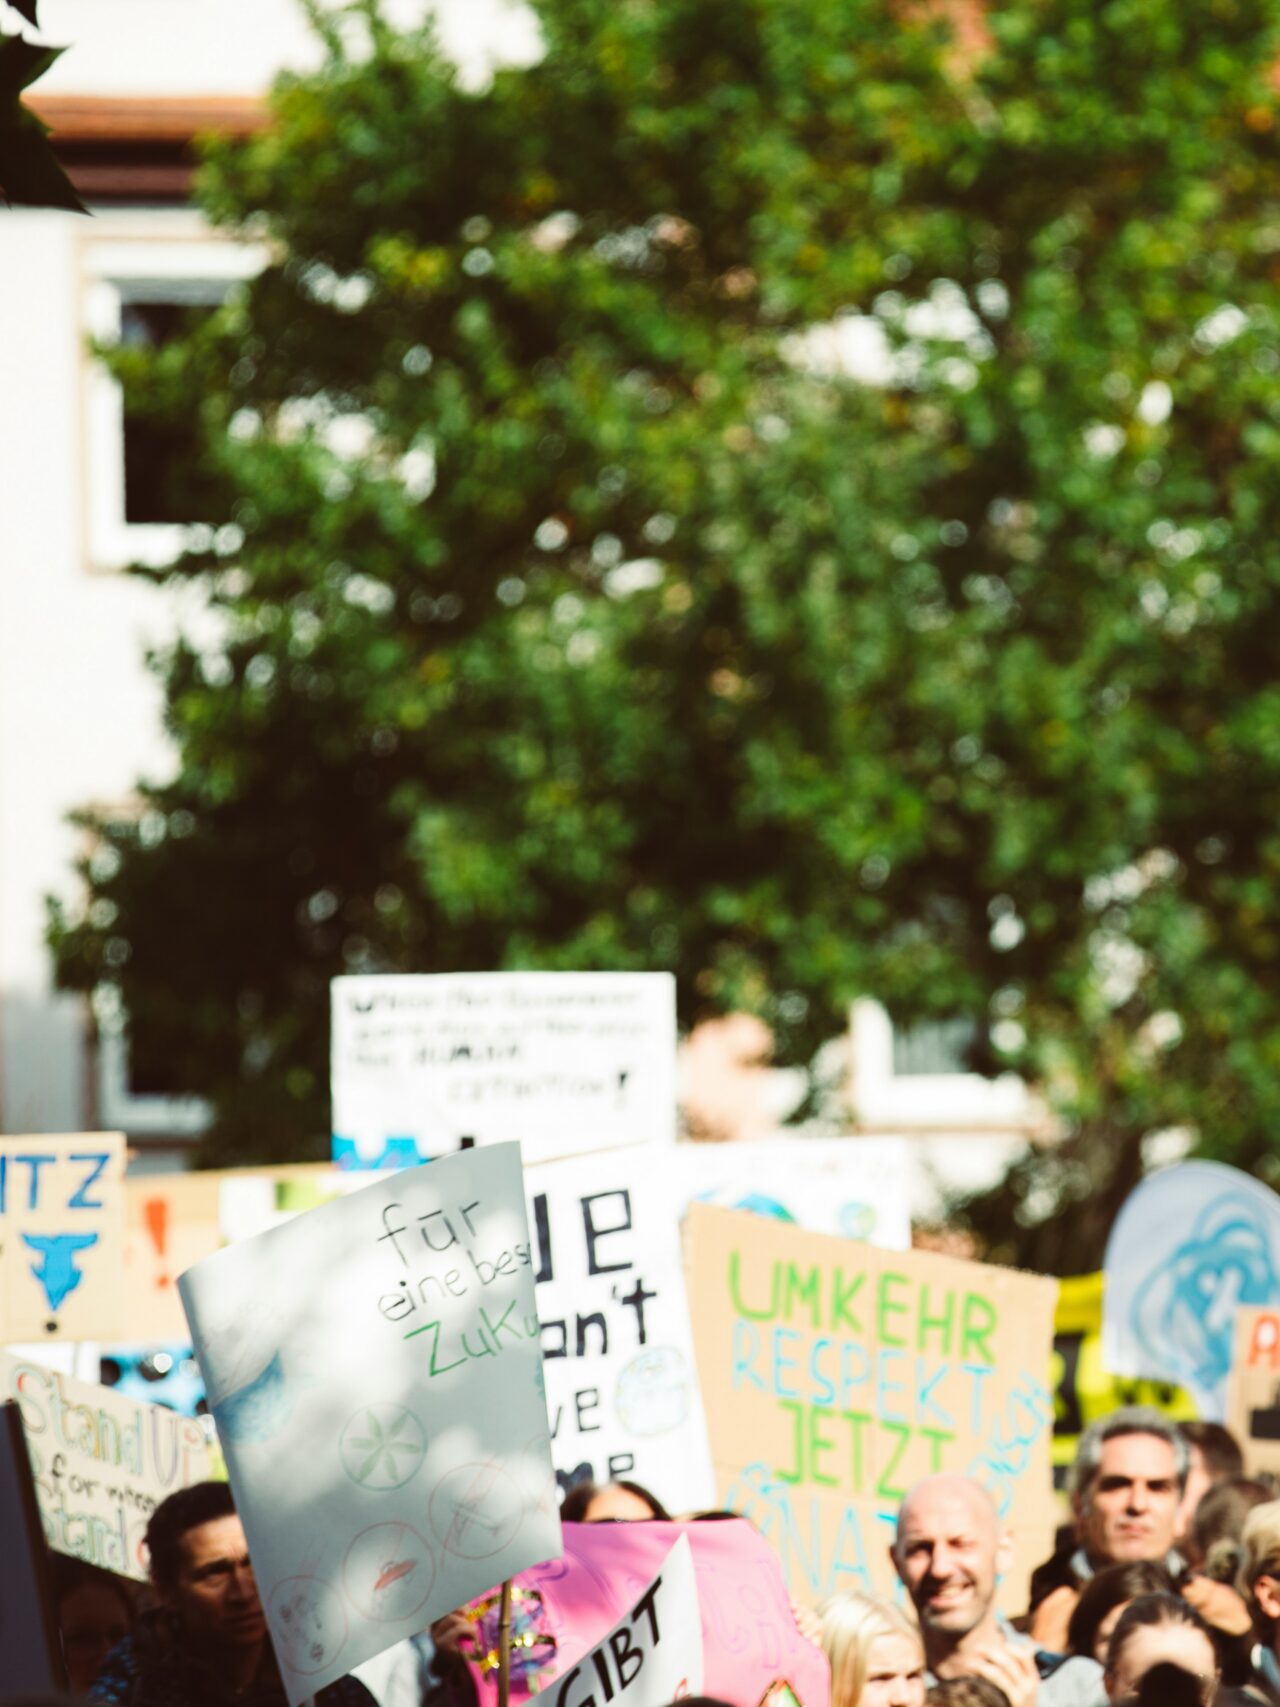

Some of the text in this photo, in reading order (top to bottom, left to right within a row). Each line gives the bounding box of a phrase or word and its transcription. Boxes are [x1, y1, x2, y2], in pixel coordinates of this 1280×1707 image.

[727, 1250, 1000, 1366] UMKEHR
[732, 1319, 996, 1436] RESPEKT
[771, 1401, 956, 1500] JETZT
